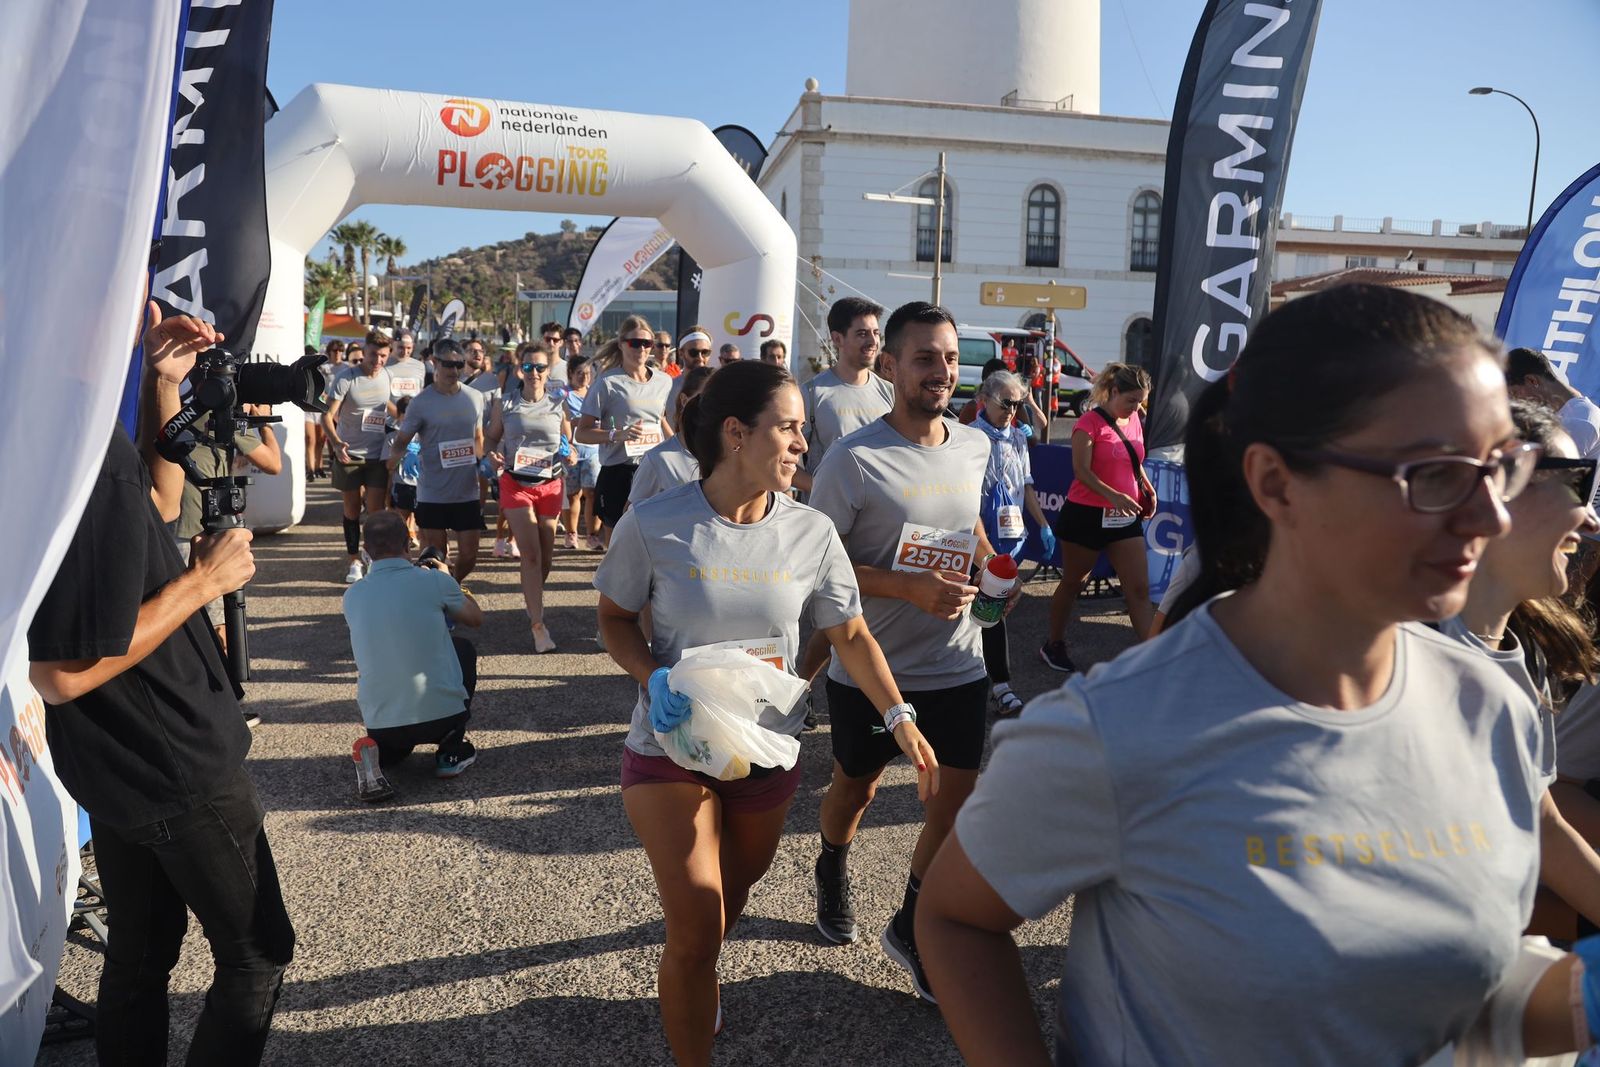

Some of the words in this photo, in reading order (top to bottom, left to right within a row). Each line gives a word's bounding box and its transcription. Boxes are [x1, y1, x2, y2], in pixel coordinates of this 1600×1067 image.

[500, 107, 579, 122] nationale
[501, 119, 608, 139] nederlanden
[152, 0, 242, 325] ARMI
[567, 143, 608, 161] TOUR
[437, 149, 609, 196] PLOGGING
[1192, 3, 1290, 382] GARMIN
[165, 407, 198, 439] RONIN
[445, 447, 471, 458] 25192
[903, 547, 965, 572] 25750
[1246, 821, 1492, 867] BESTSELLER
